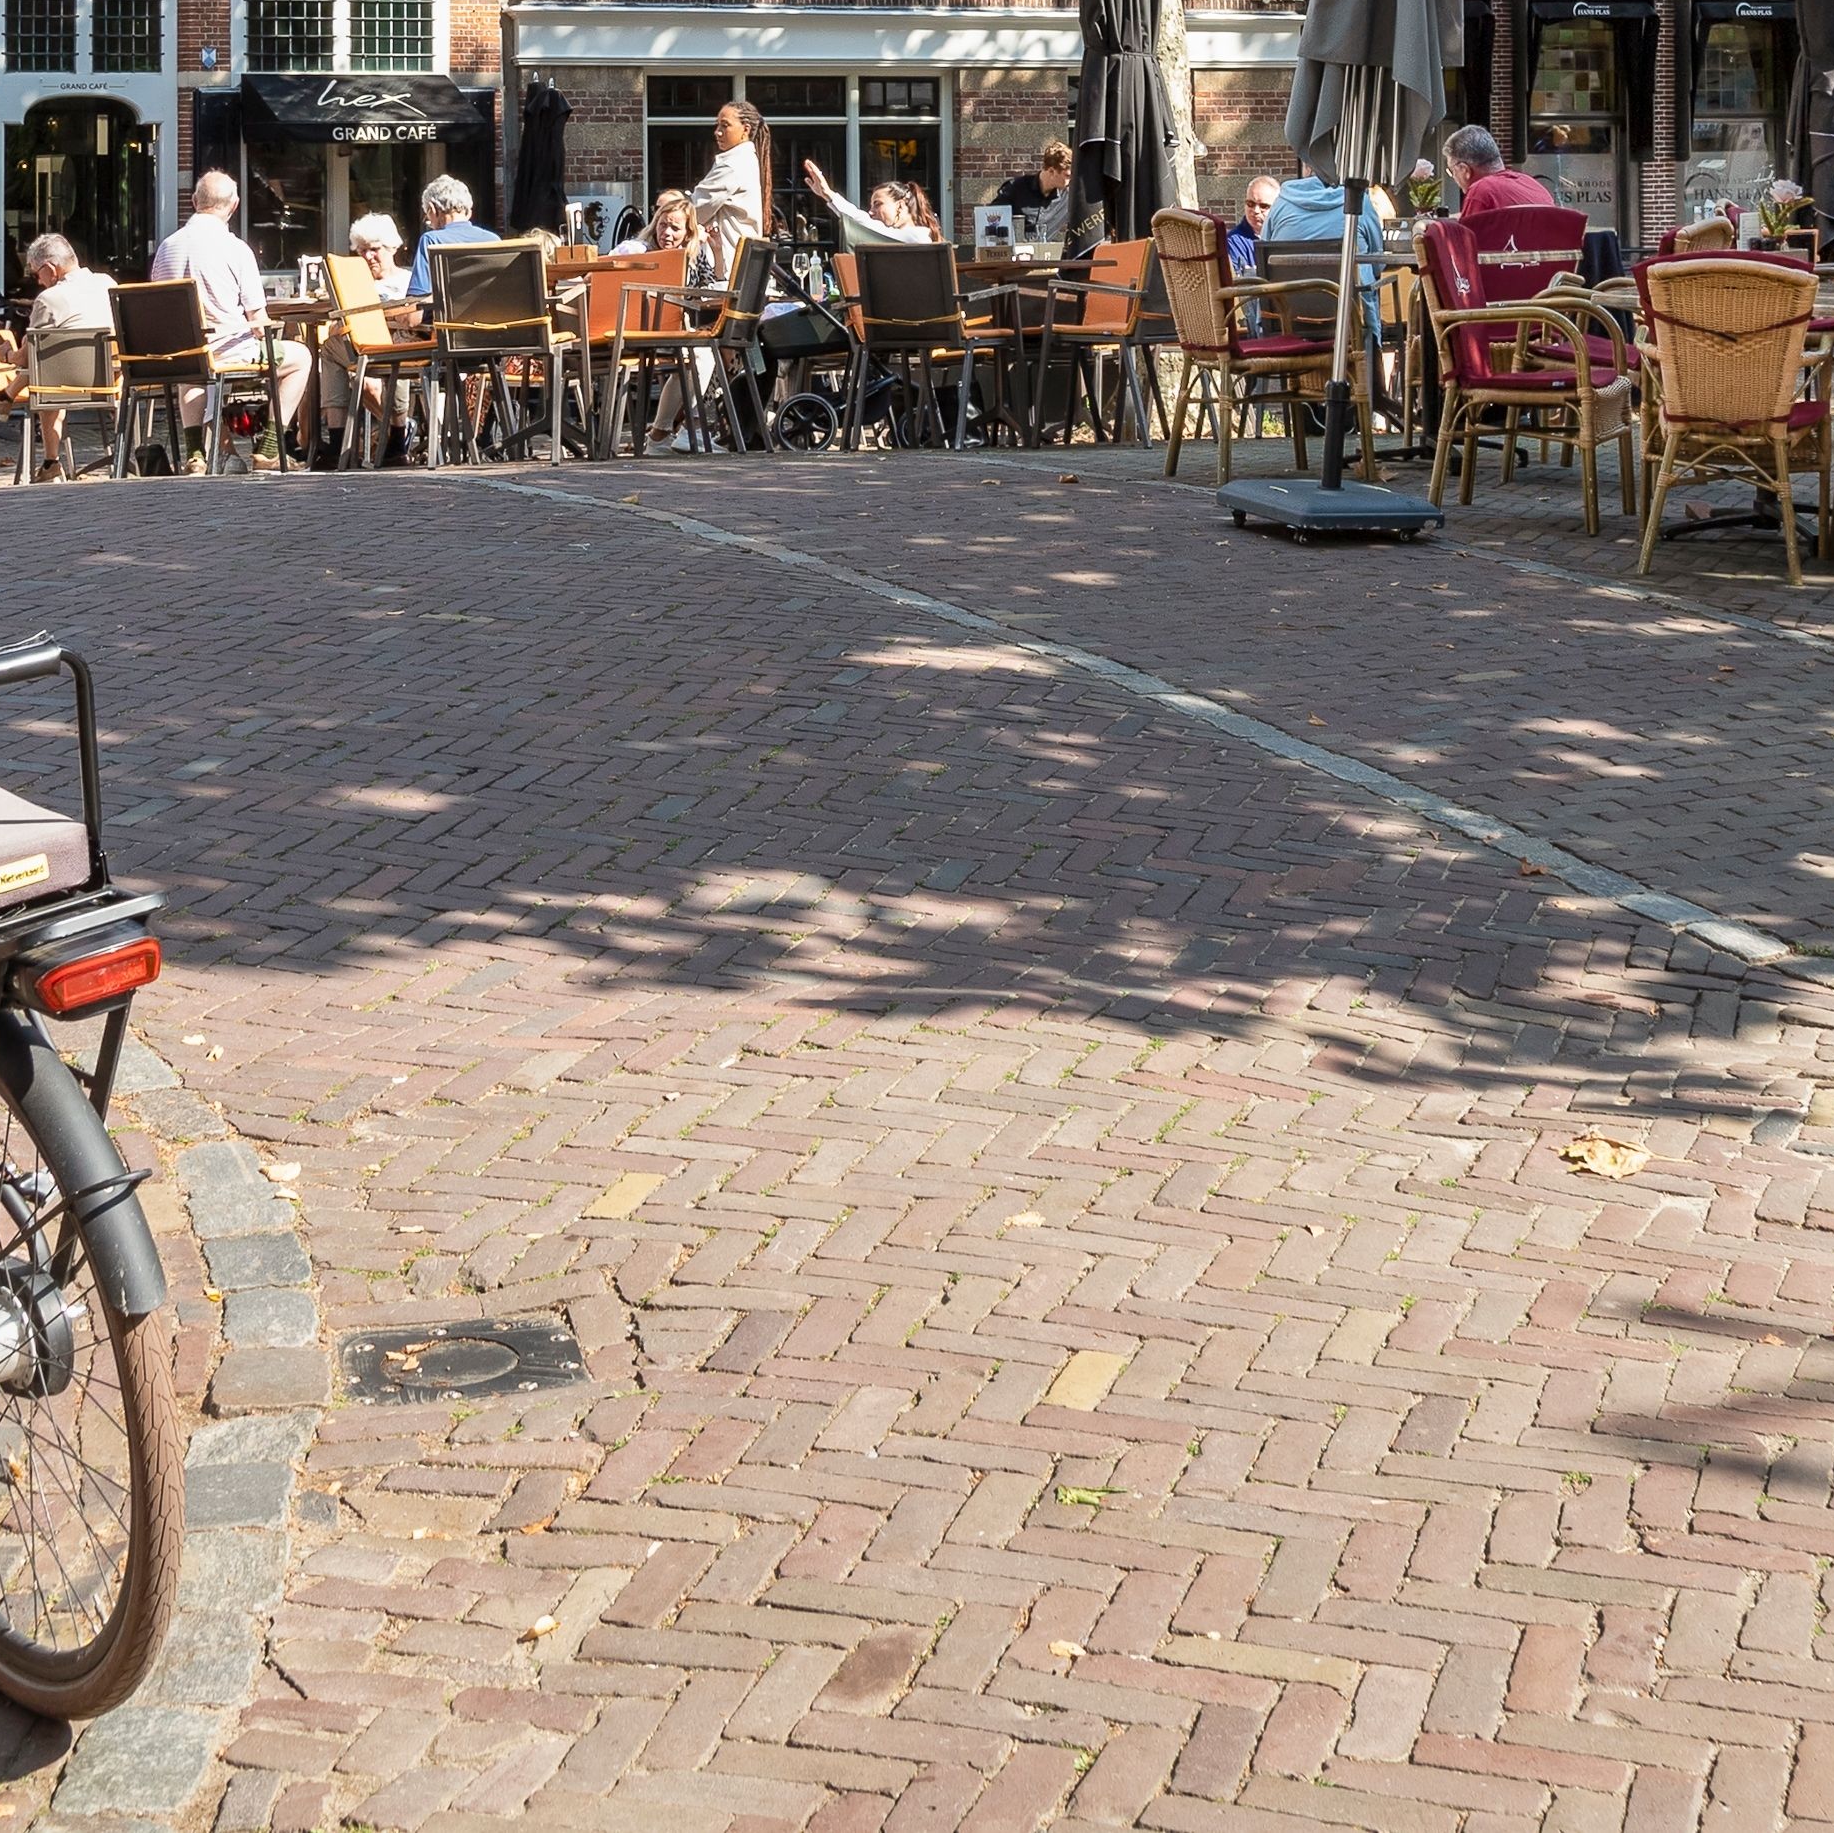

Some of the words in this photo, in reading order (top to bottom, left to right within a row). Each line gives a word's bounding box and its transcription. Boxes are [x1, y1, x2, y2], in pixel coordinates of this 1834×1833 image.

[60, 82, 87, 90] GRAND
[88, 82, 108, 90] CAFÉ
[317, 78, 427, 117] hex
[332, 126, 391, 141] GRAND
[396, 123, 437, 140] CAFÉ
[1577, 191, 1611, 203] PLAS
[1694, 188, 1732, 200] HANS
[1738, 188, 1770, 200] PLA
